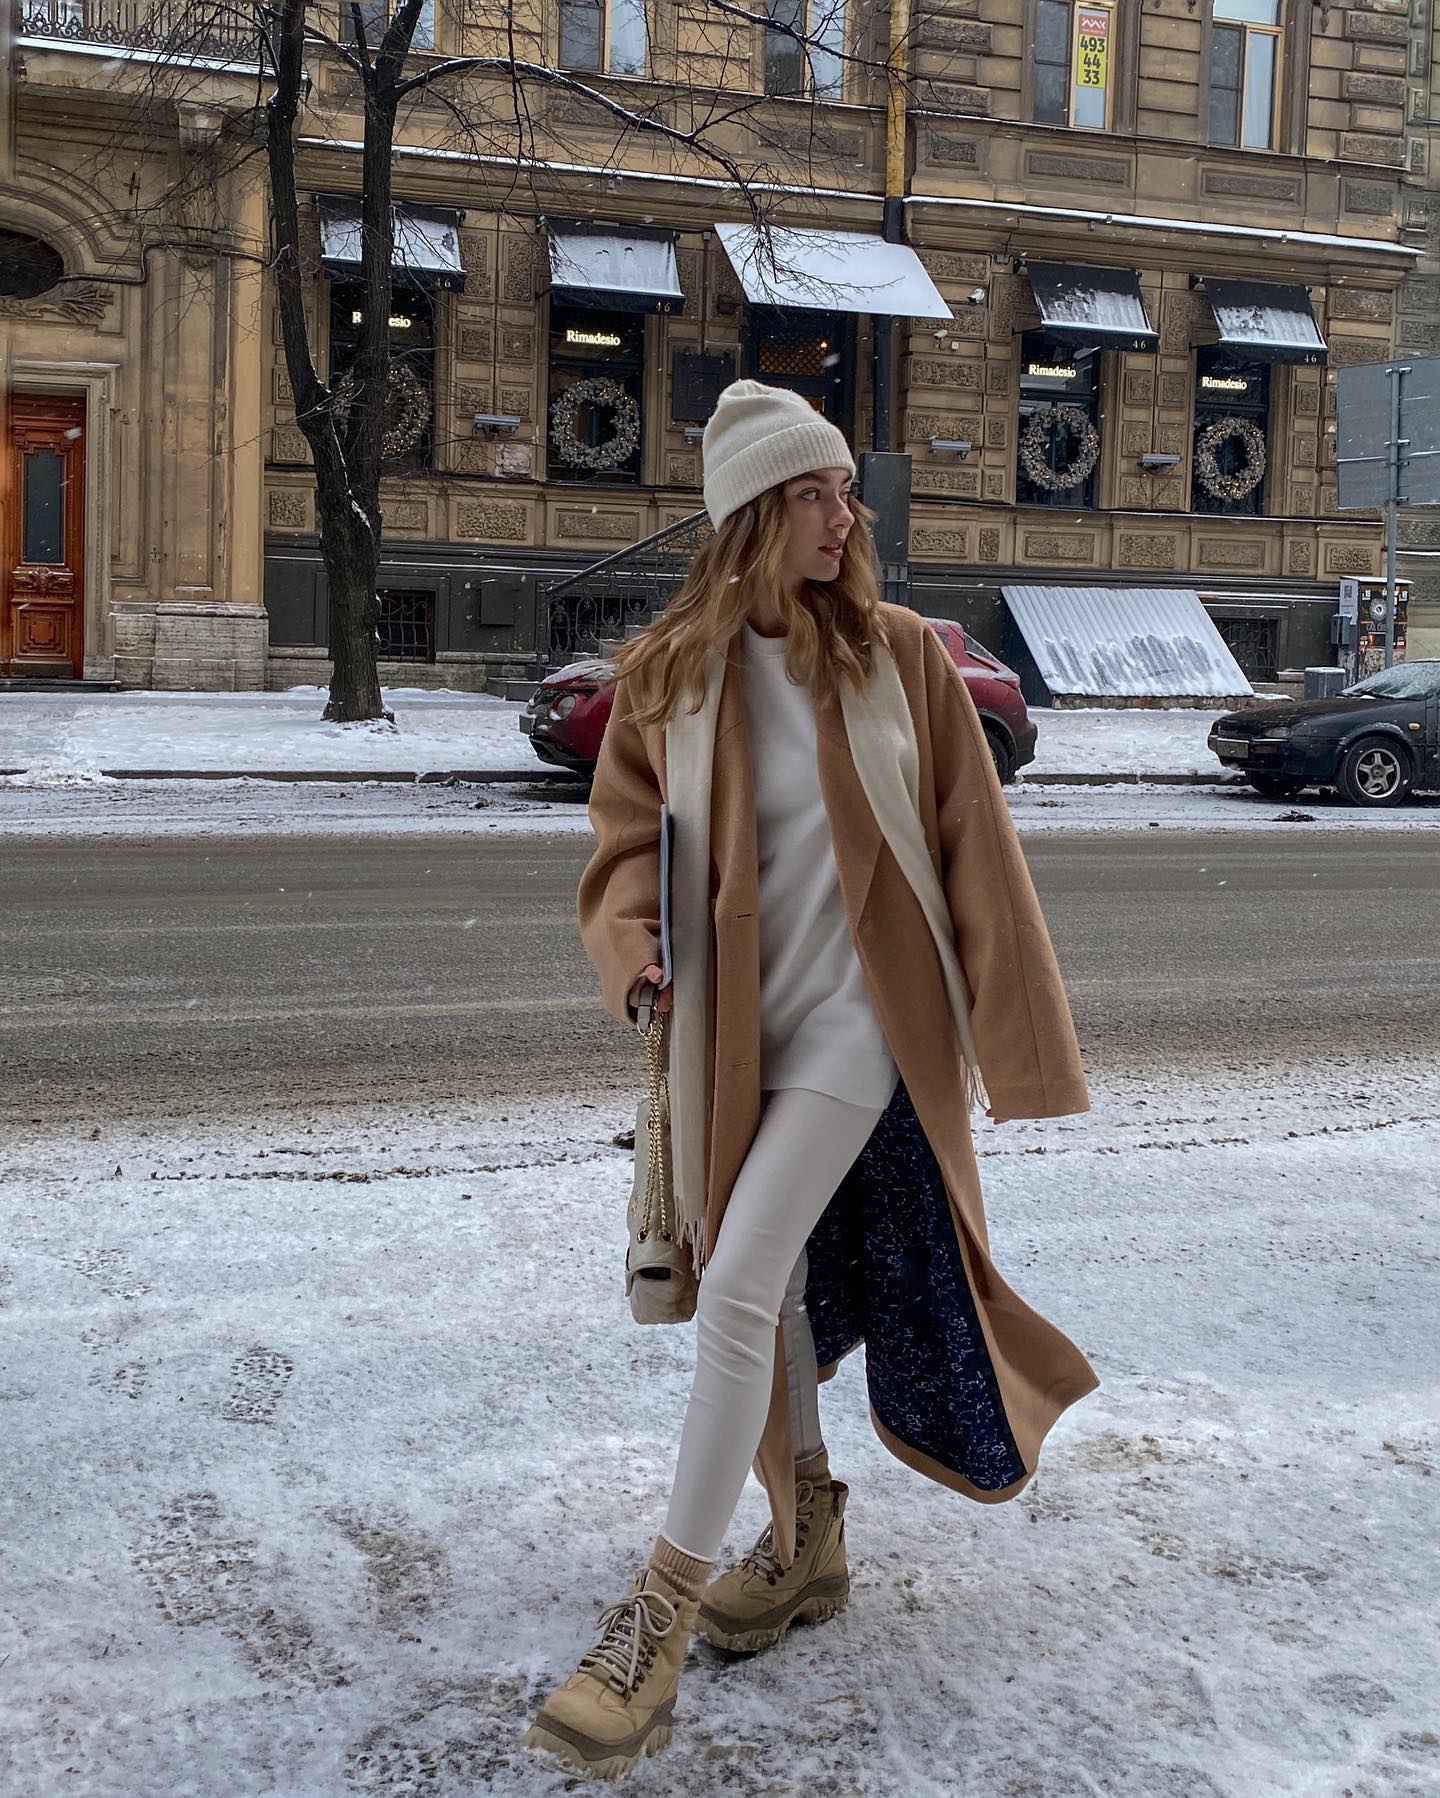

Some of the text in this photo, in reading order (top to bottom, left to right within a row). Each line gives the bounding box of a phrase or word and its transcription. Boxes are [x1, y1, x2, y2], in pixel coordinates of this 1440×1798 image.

[1080, 36, 1105, 53] 493
[1083, 54, 1101, 69] 44
[1083, 69, 1100, 85] 33
[435, 277, 451, 288] 46
[656, 302, 671, 312] 46
[566, 330, 620, 346] Rimadesio
[1132, 340, 1147, 350] 46
[1304, 354, 1317, 364] 46
[1029, 363, 1076, 378] Rimadesio
[1202, 376, 1247, 391] Rimadesio
